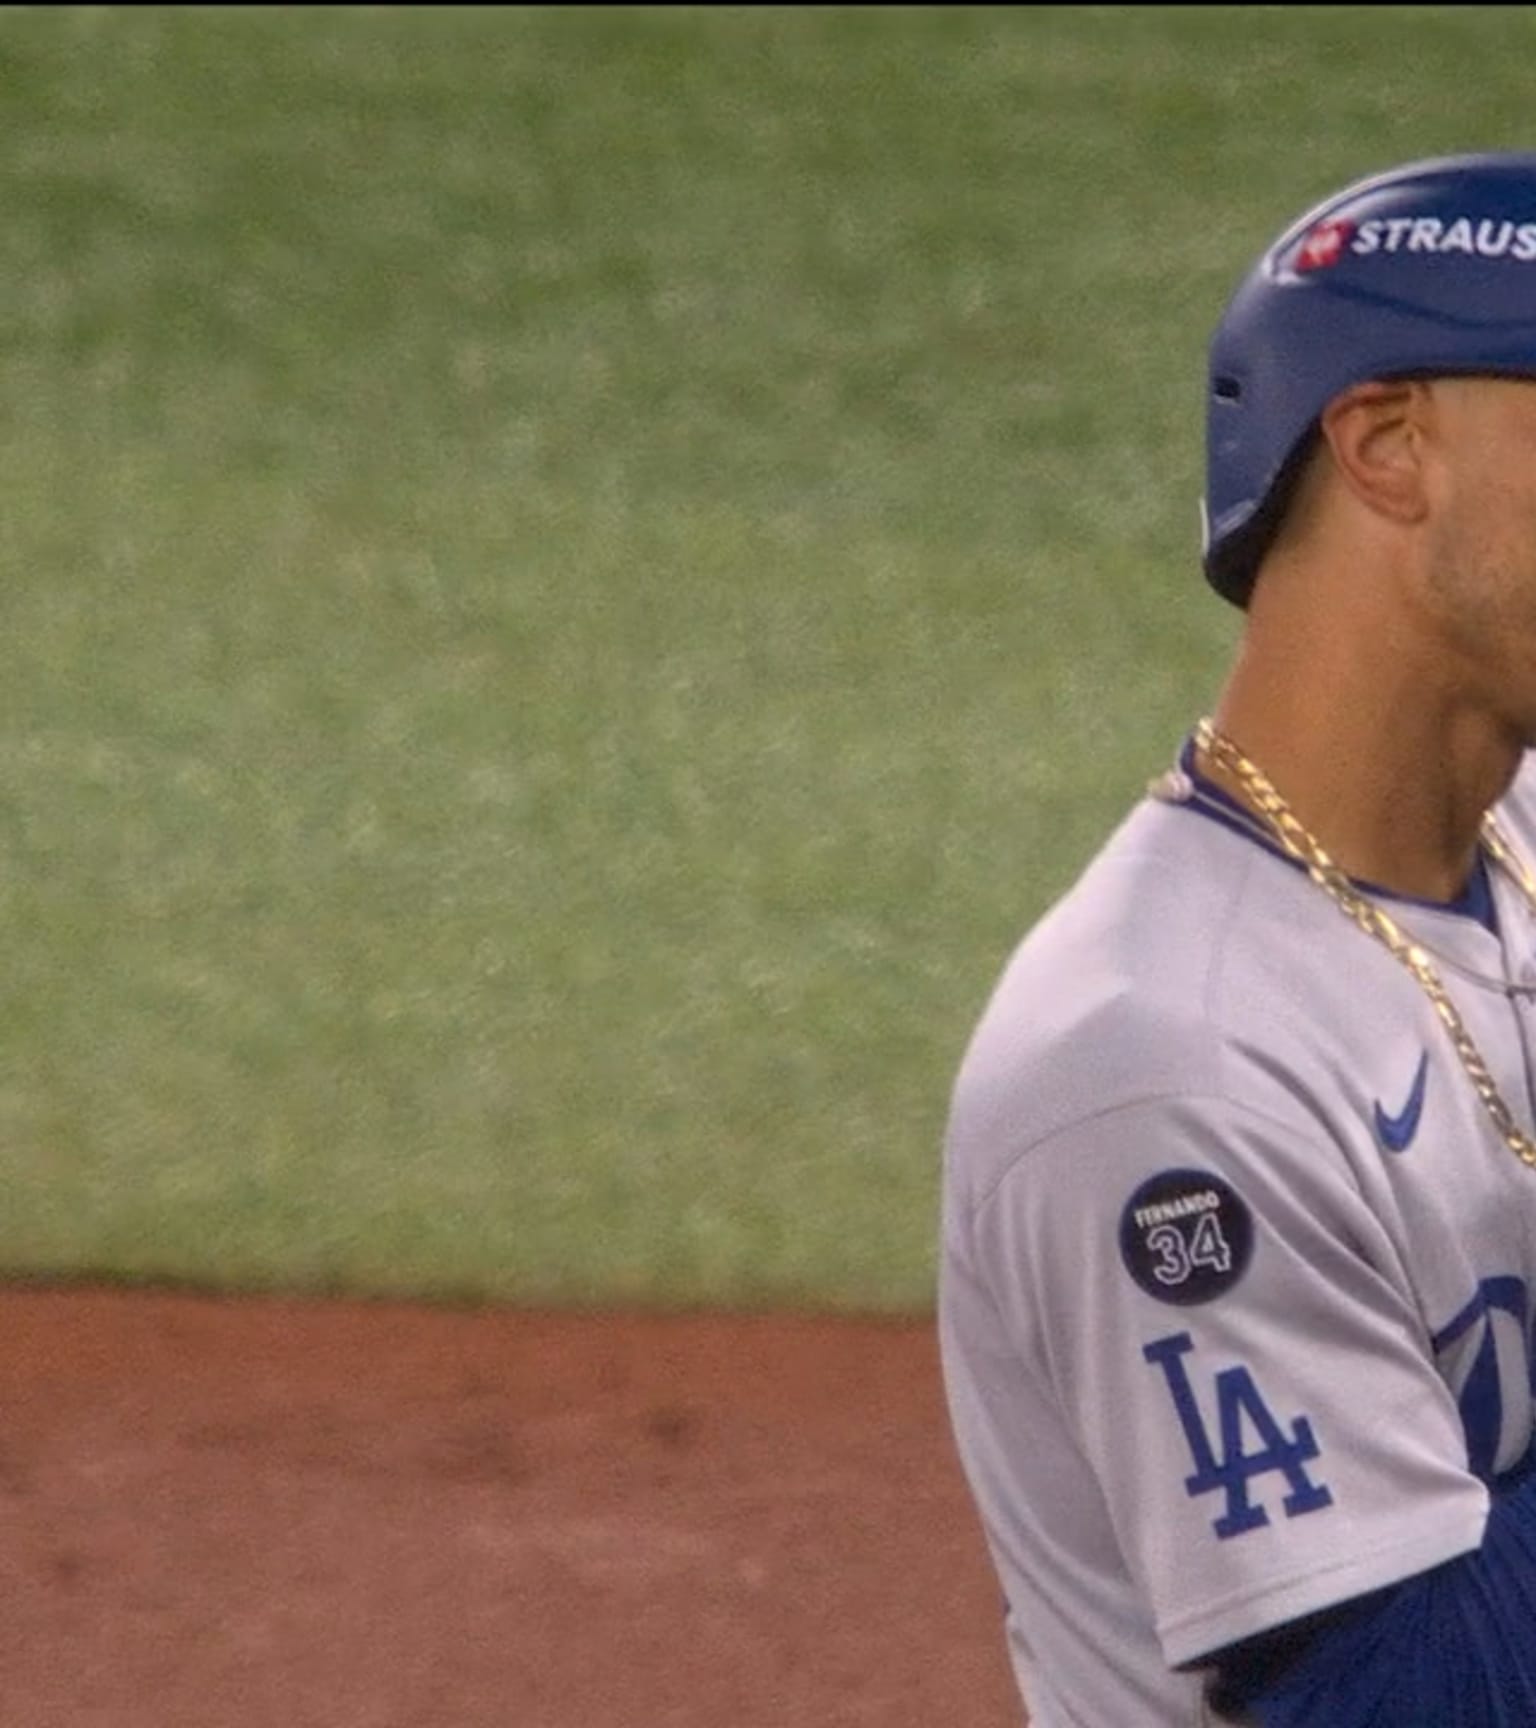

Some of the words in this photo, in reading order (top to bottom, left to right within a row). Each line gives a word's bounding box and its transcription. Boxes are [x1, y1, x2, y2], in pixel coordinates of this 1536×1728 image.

[1134, 1189, 1220, 1229] FERNANDO
[1146, 1211, 1231, 1285] 34
[1142, 1332, 1334, 1541] LA
